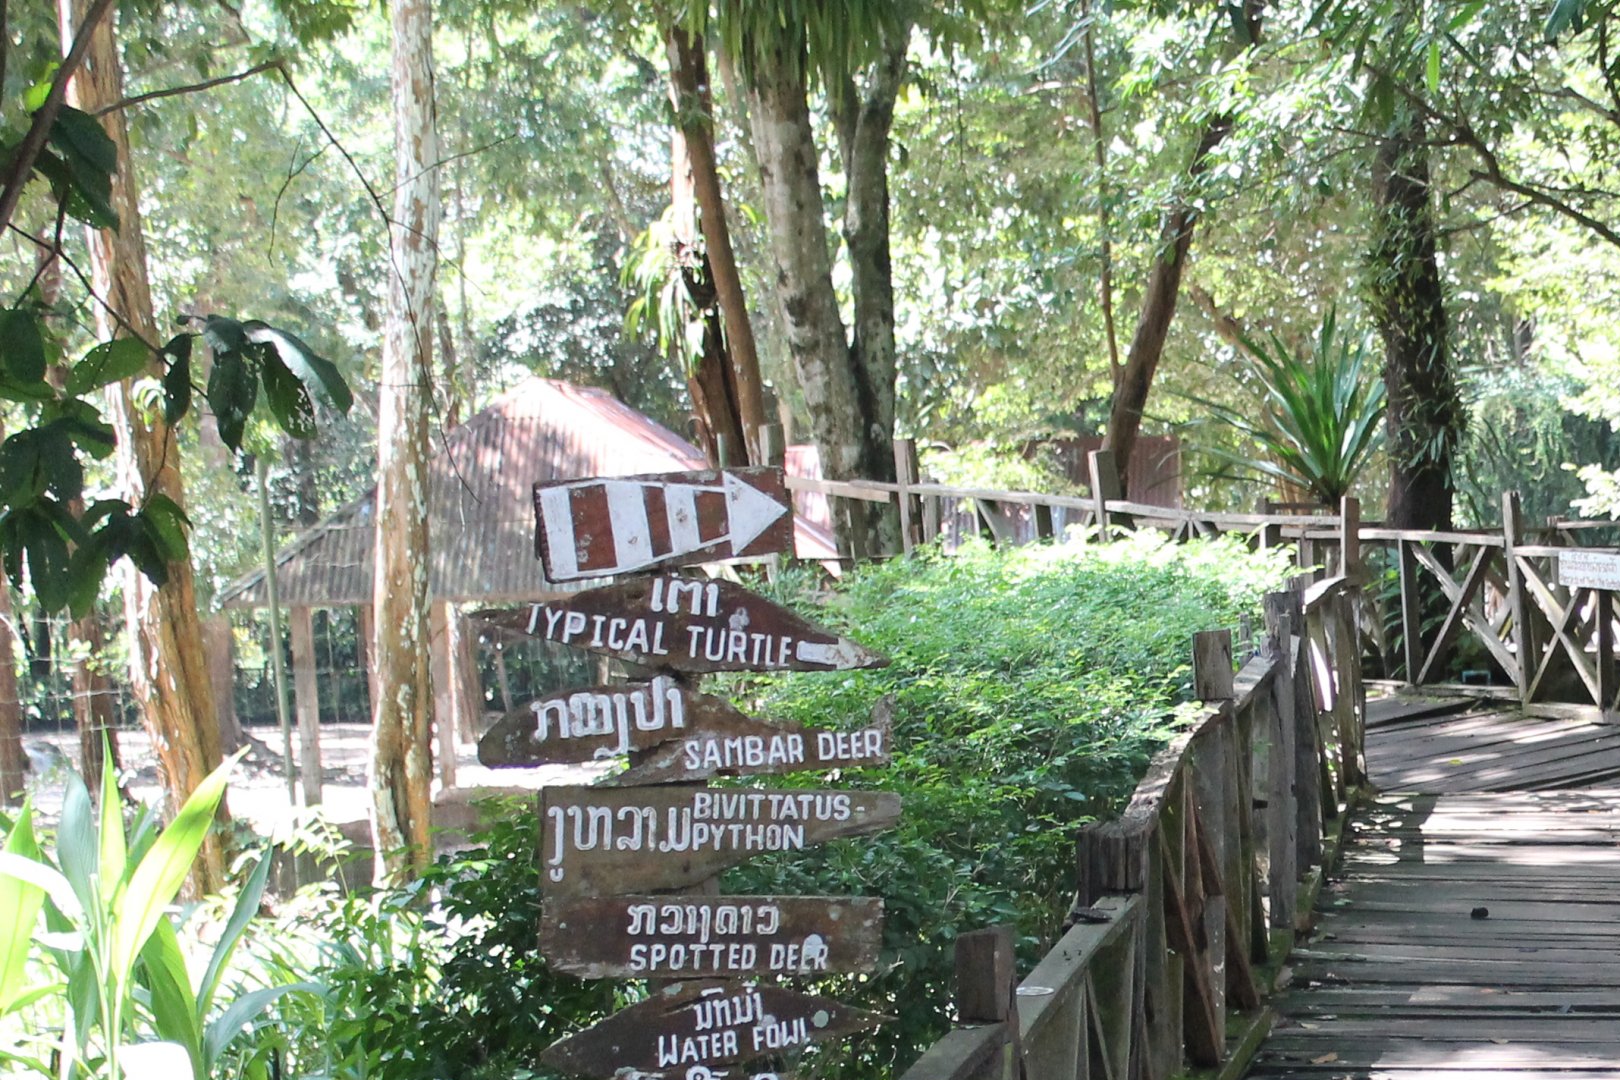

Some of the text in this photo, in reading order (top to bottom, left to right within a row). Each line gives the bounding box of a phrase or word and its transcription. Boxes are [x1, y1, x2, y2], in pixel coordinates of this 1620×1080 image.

[526, 602, 793, 668] TYPICAL TURTLE
[685, 729, 882, 770] SAMBAR DEER
[692, 823, 804, 851] PYTHON
[630, 943, 829, 971] SPOTTED DEER
[657, 1029, 738, 1068] WATER
